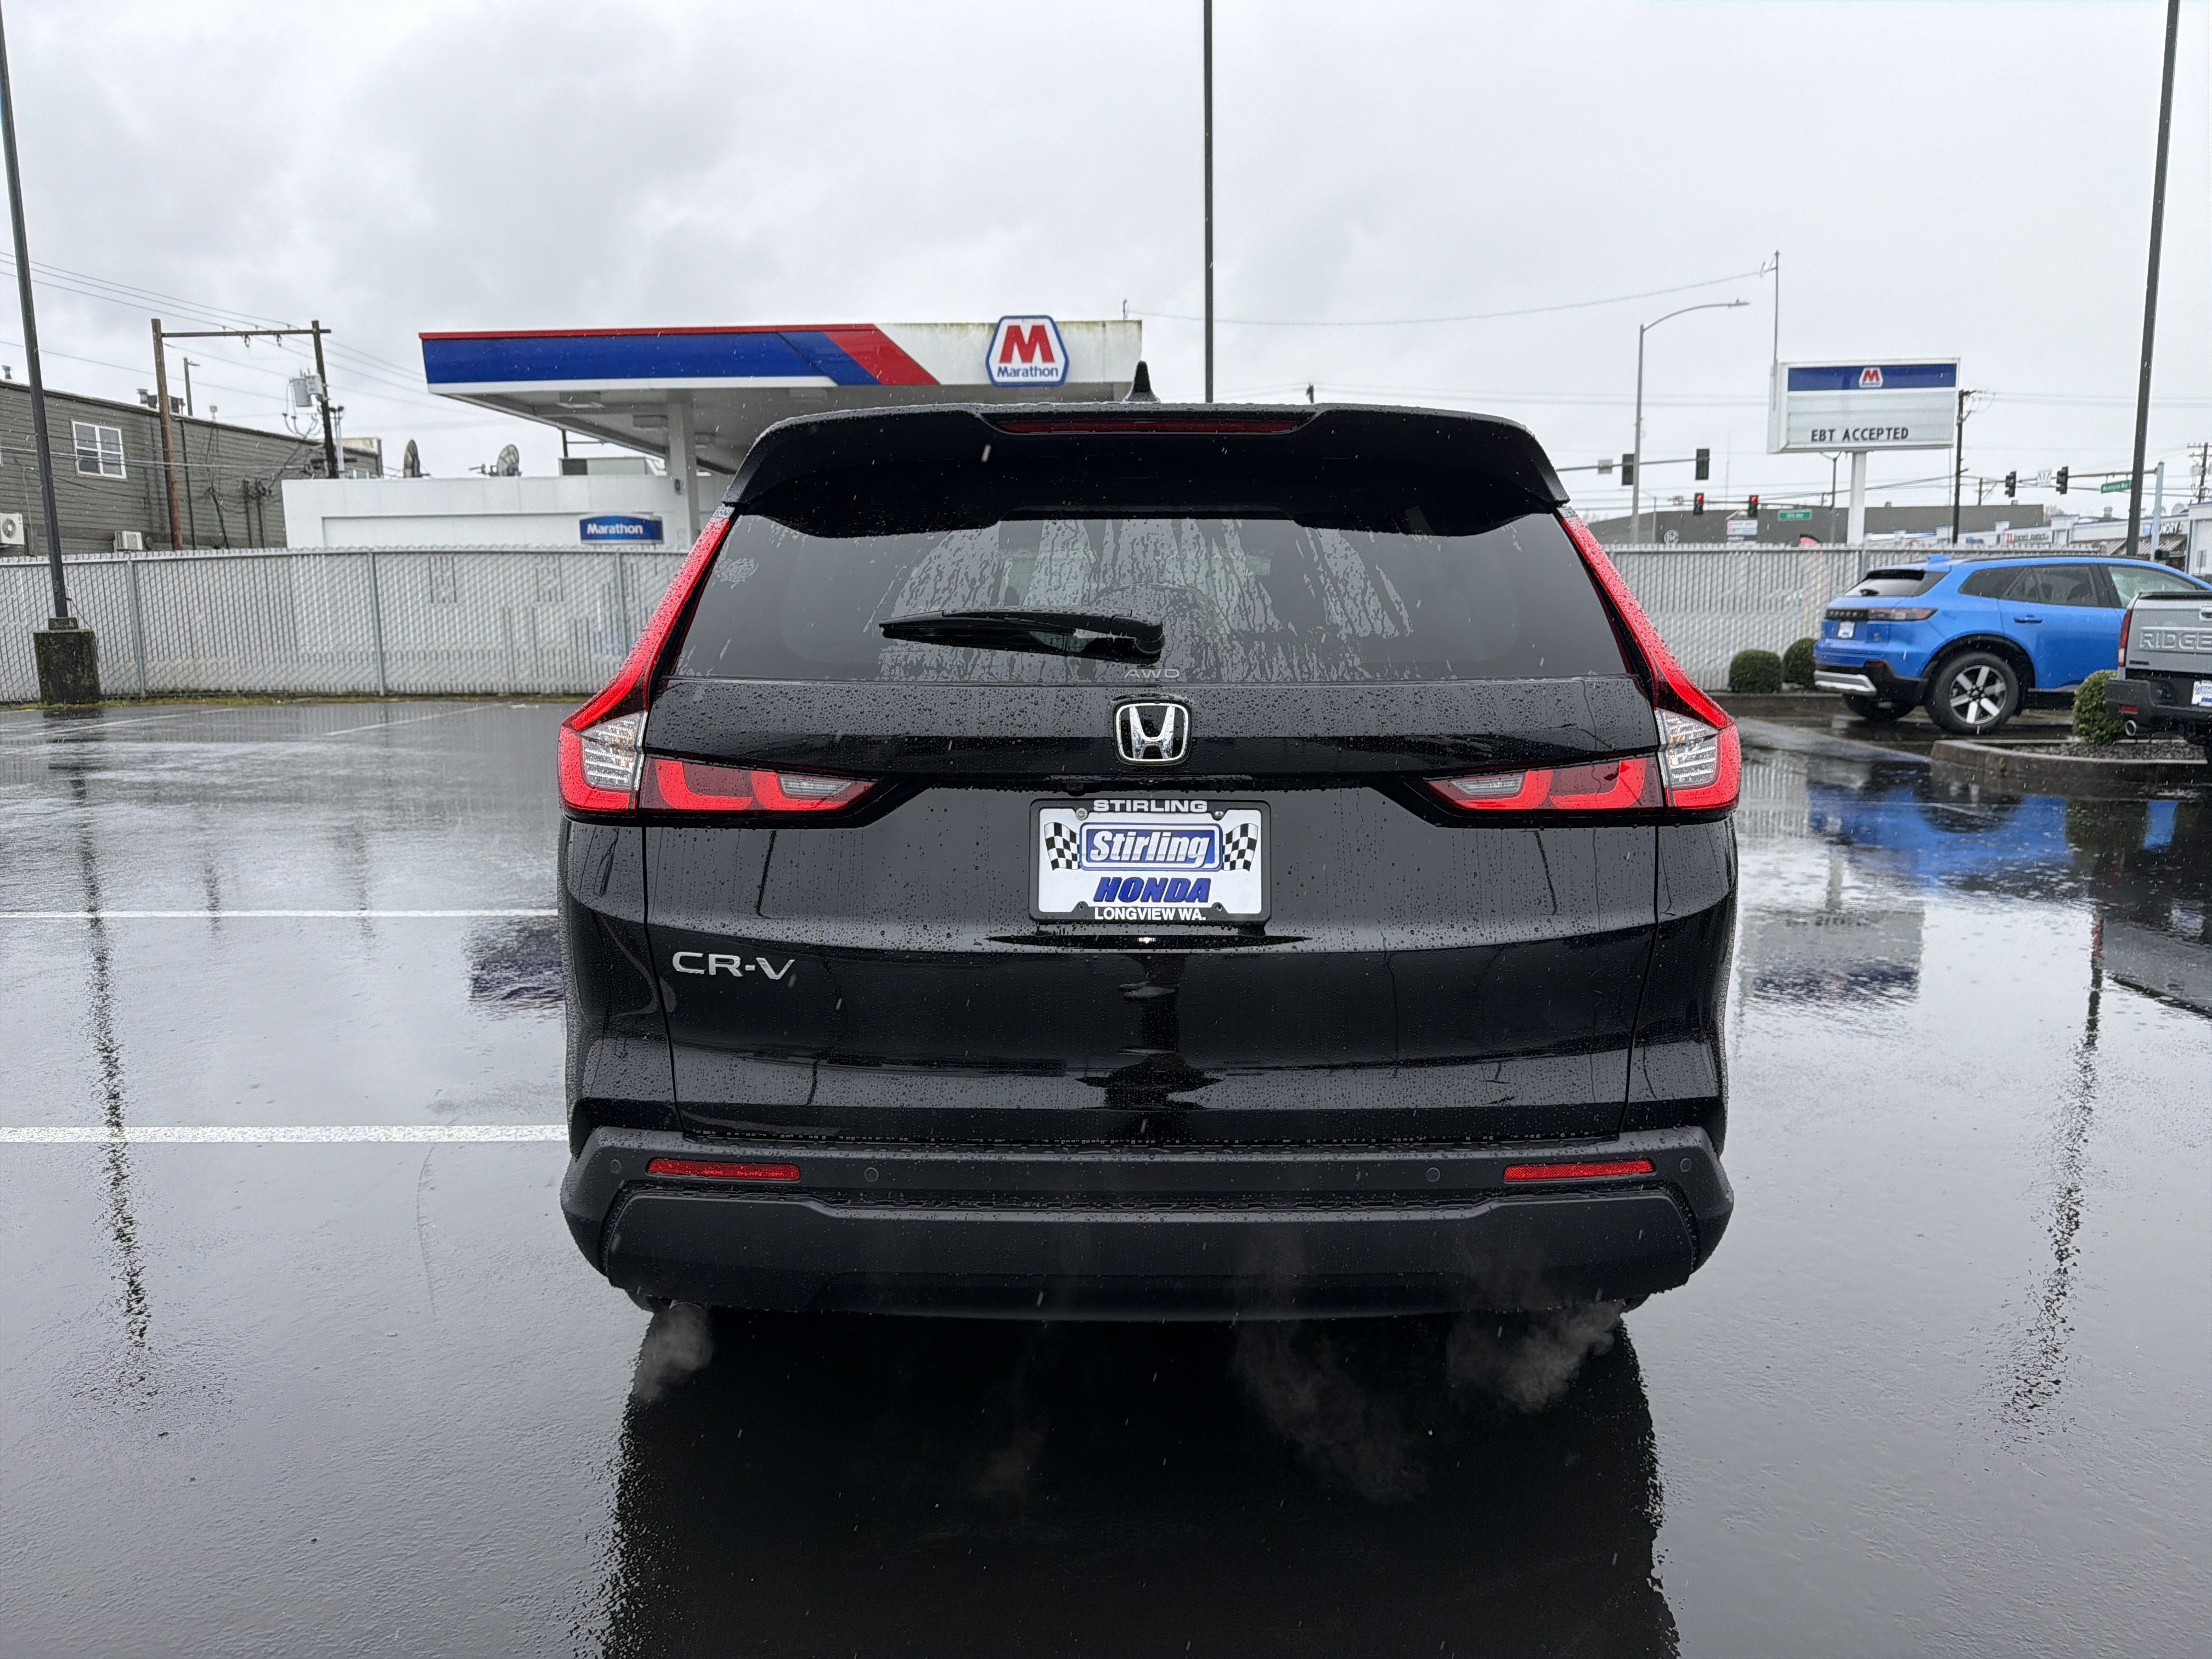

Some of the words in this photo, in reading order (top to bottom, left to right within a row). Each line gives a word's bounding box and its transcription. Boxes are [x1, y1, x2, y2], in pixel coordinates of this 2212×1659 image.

[999, 325, 1055, 363] M
[997, 366, 1058, 377] Marathon
[1862, 370, 1880, 382] M
[1812, 429, 1836, 442] EBT
[1842, 427, 1909, 441] ACCEPTED
[587, 523, 643, 534] Marathon
[2140, 632, 2212, 651] RIDGE
[1125, 669, 1180, 678] AWD
[1093, 800, 1207, 812] STIRLING
[1090, 831, 1210, 867] Stirling
[1093, 877, 1211, 902] HONDA
[1094, 907, 1175, 920] LONGVIEW
[1179, 909, 1206, 921] WA.
[672, 951, 795, 980] CR-V
